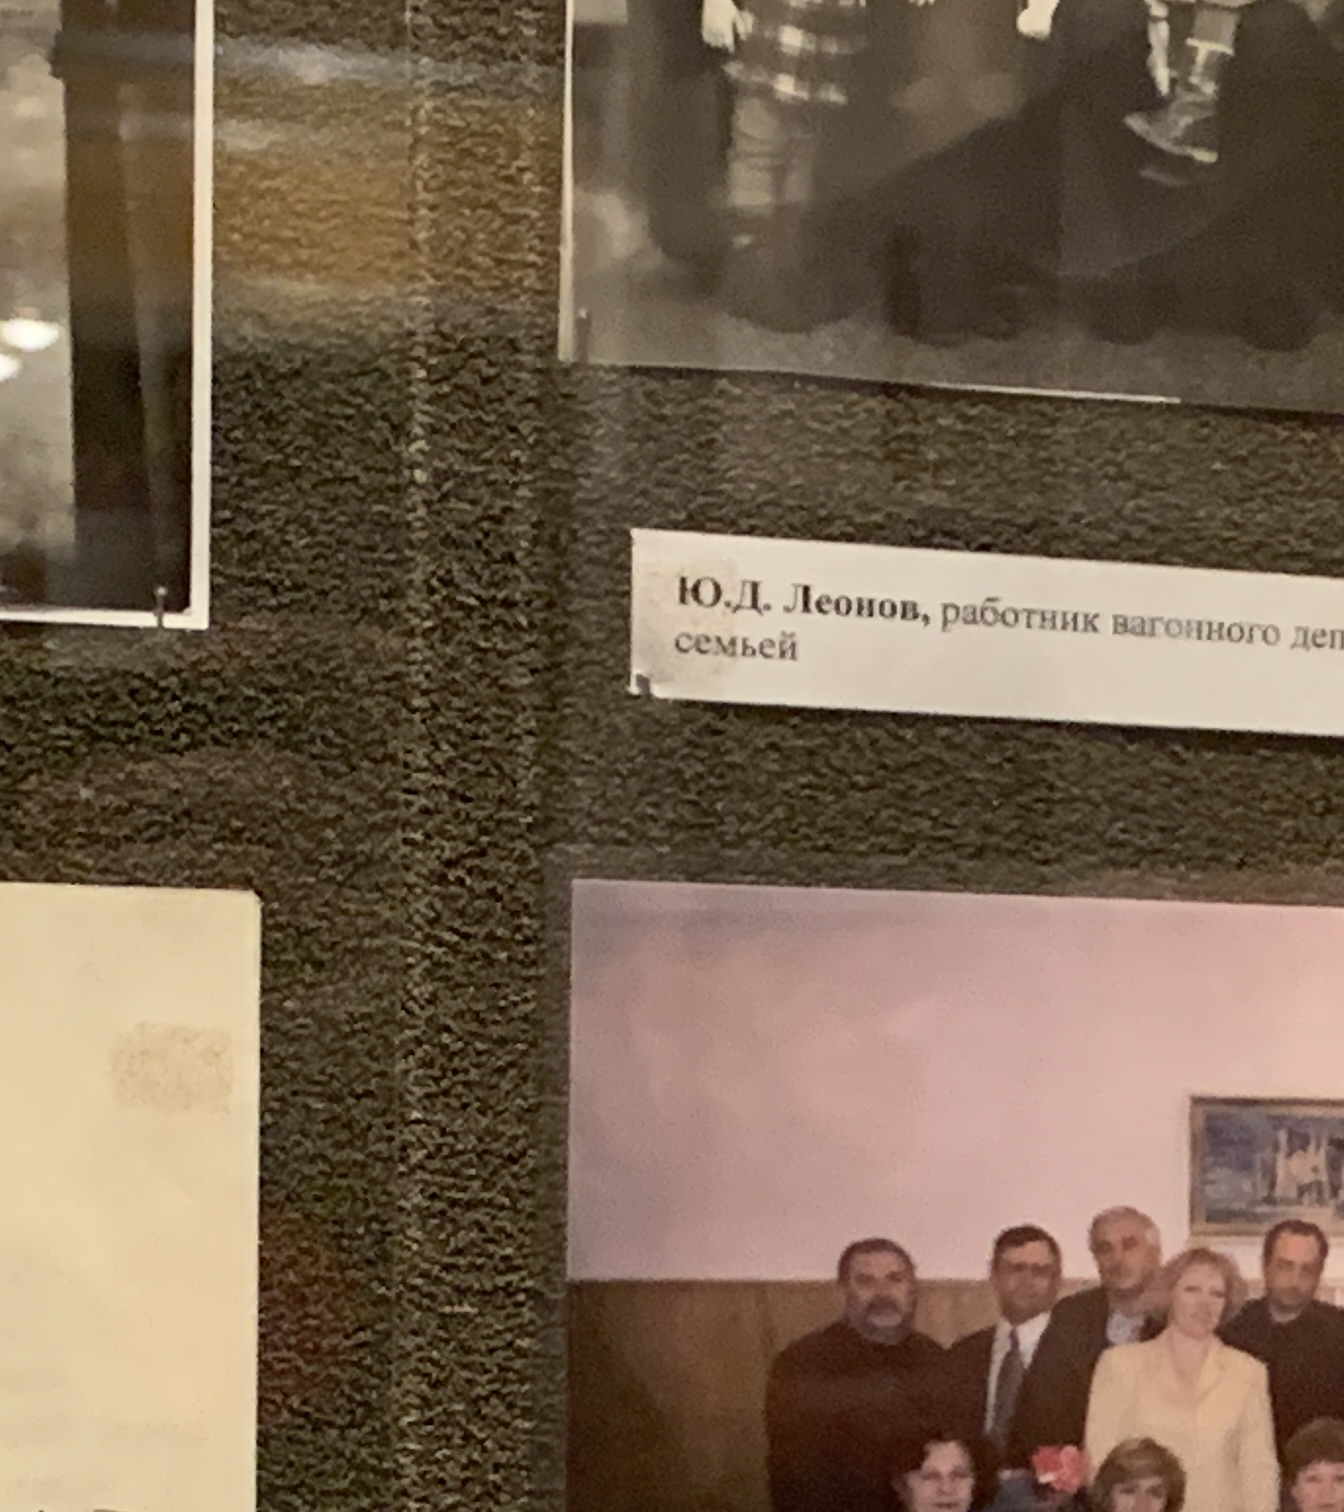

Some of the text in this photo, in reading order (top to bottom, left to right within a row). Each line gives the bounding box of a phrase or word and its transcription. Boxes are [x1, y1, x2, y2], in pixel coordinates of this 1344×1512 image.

[676, 574, 772, 616] Ю.Д.
[784, 583, 932, 627] Леонов,
[940, 597, 1102, 637] работник
[1111, 612, 1282, 648] вагонного
[674, 628, 799, 662] семьей
